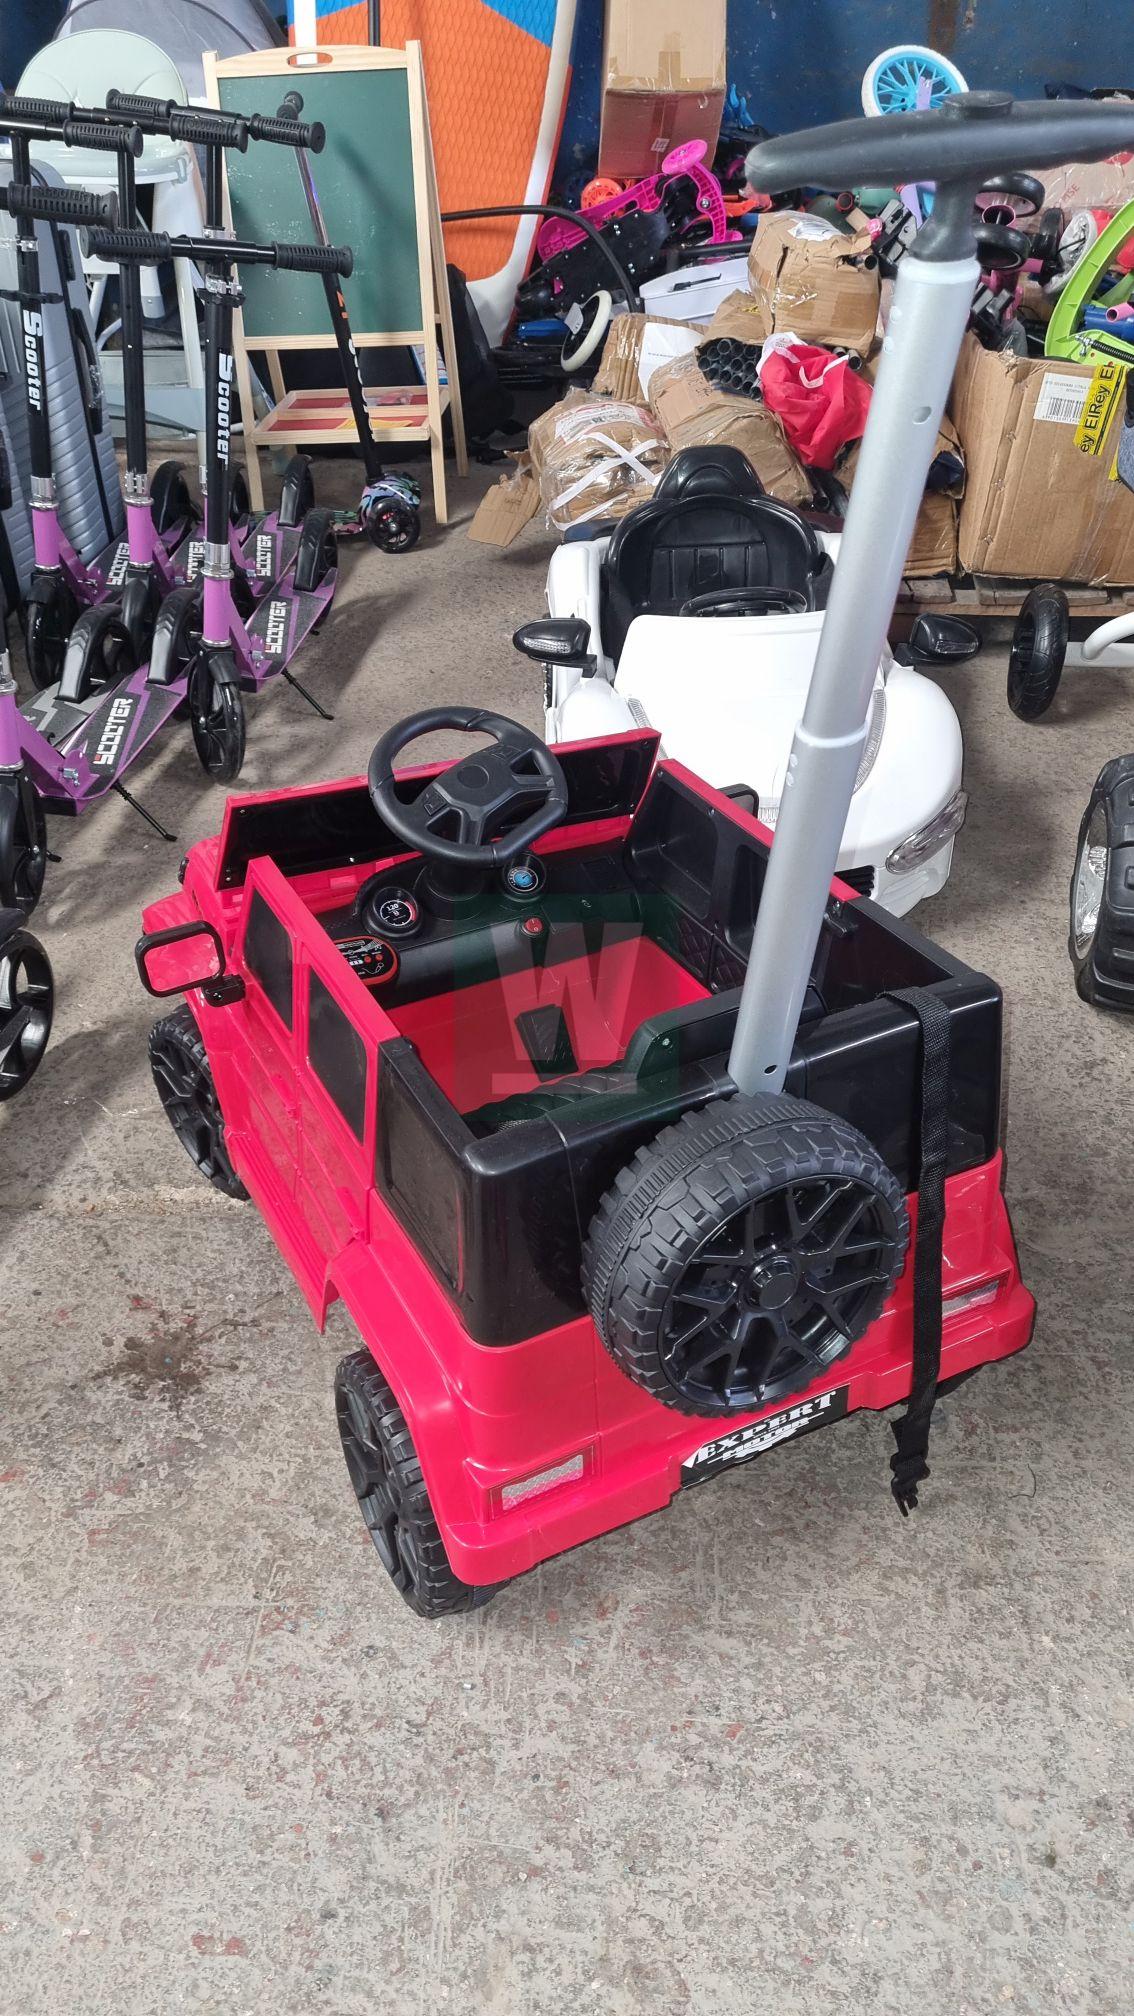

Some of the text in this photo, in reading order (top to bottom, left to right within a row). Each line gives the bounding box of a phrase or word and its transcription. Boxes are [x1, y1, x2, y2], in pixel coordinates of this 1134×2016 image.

[23, 309, 43, 411] Scooter
[256, 535, 272, 577] SCOOTER
[264, 600, 287, 654] SCOOTER
[93, 698, 133, 765] SCOOTER
[695, 1391, 837, 1464] EXPERT
